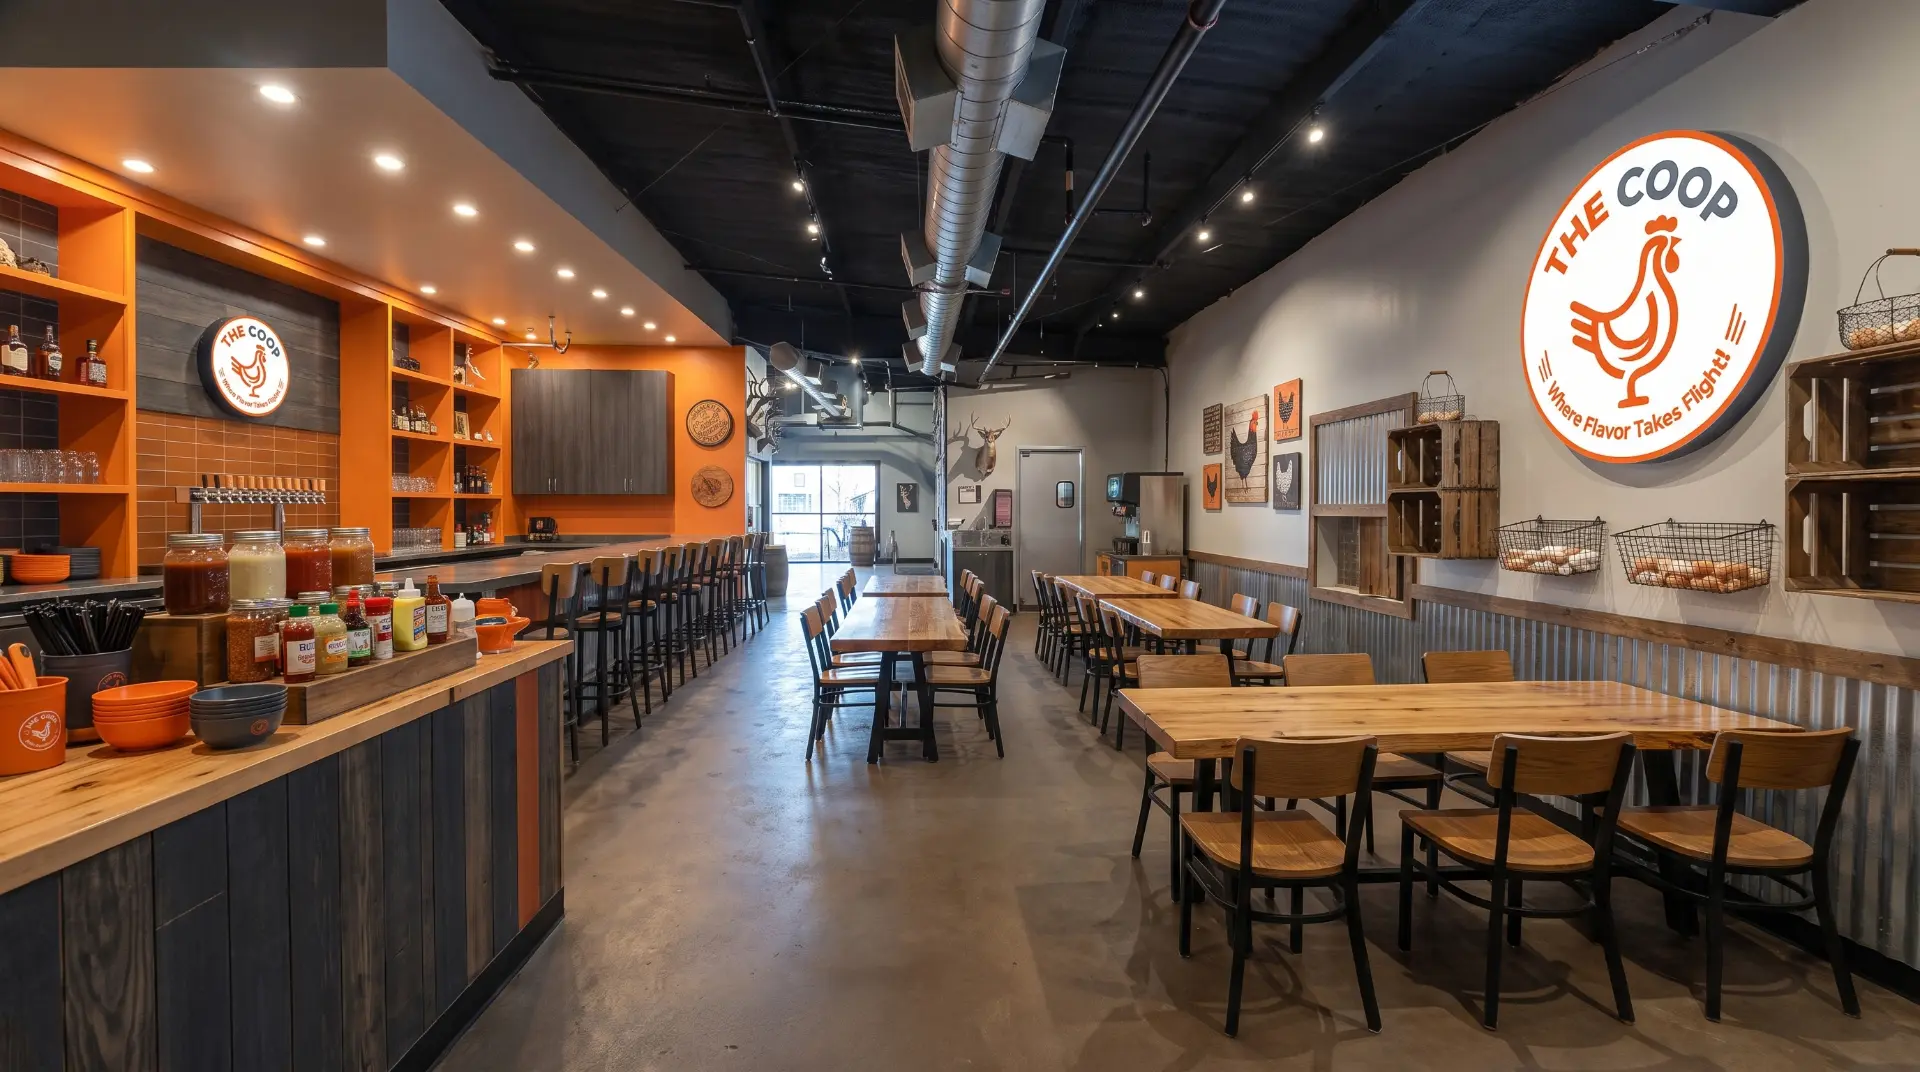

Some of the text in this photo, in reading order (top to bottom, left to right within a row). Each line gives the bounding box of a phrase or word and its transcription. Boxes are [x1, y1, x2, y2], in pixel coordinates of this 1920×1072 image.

[1544, 160, 1738, 275] THE COOP
[221, 325, 281, 357] THE COOP
[1548, 348, 1731, 440] Where Flavor Takes Flight!
